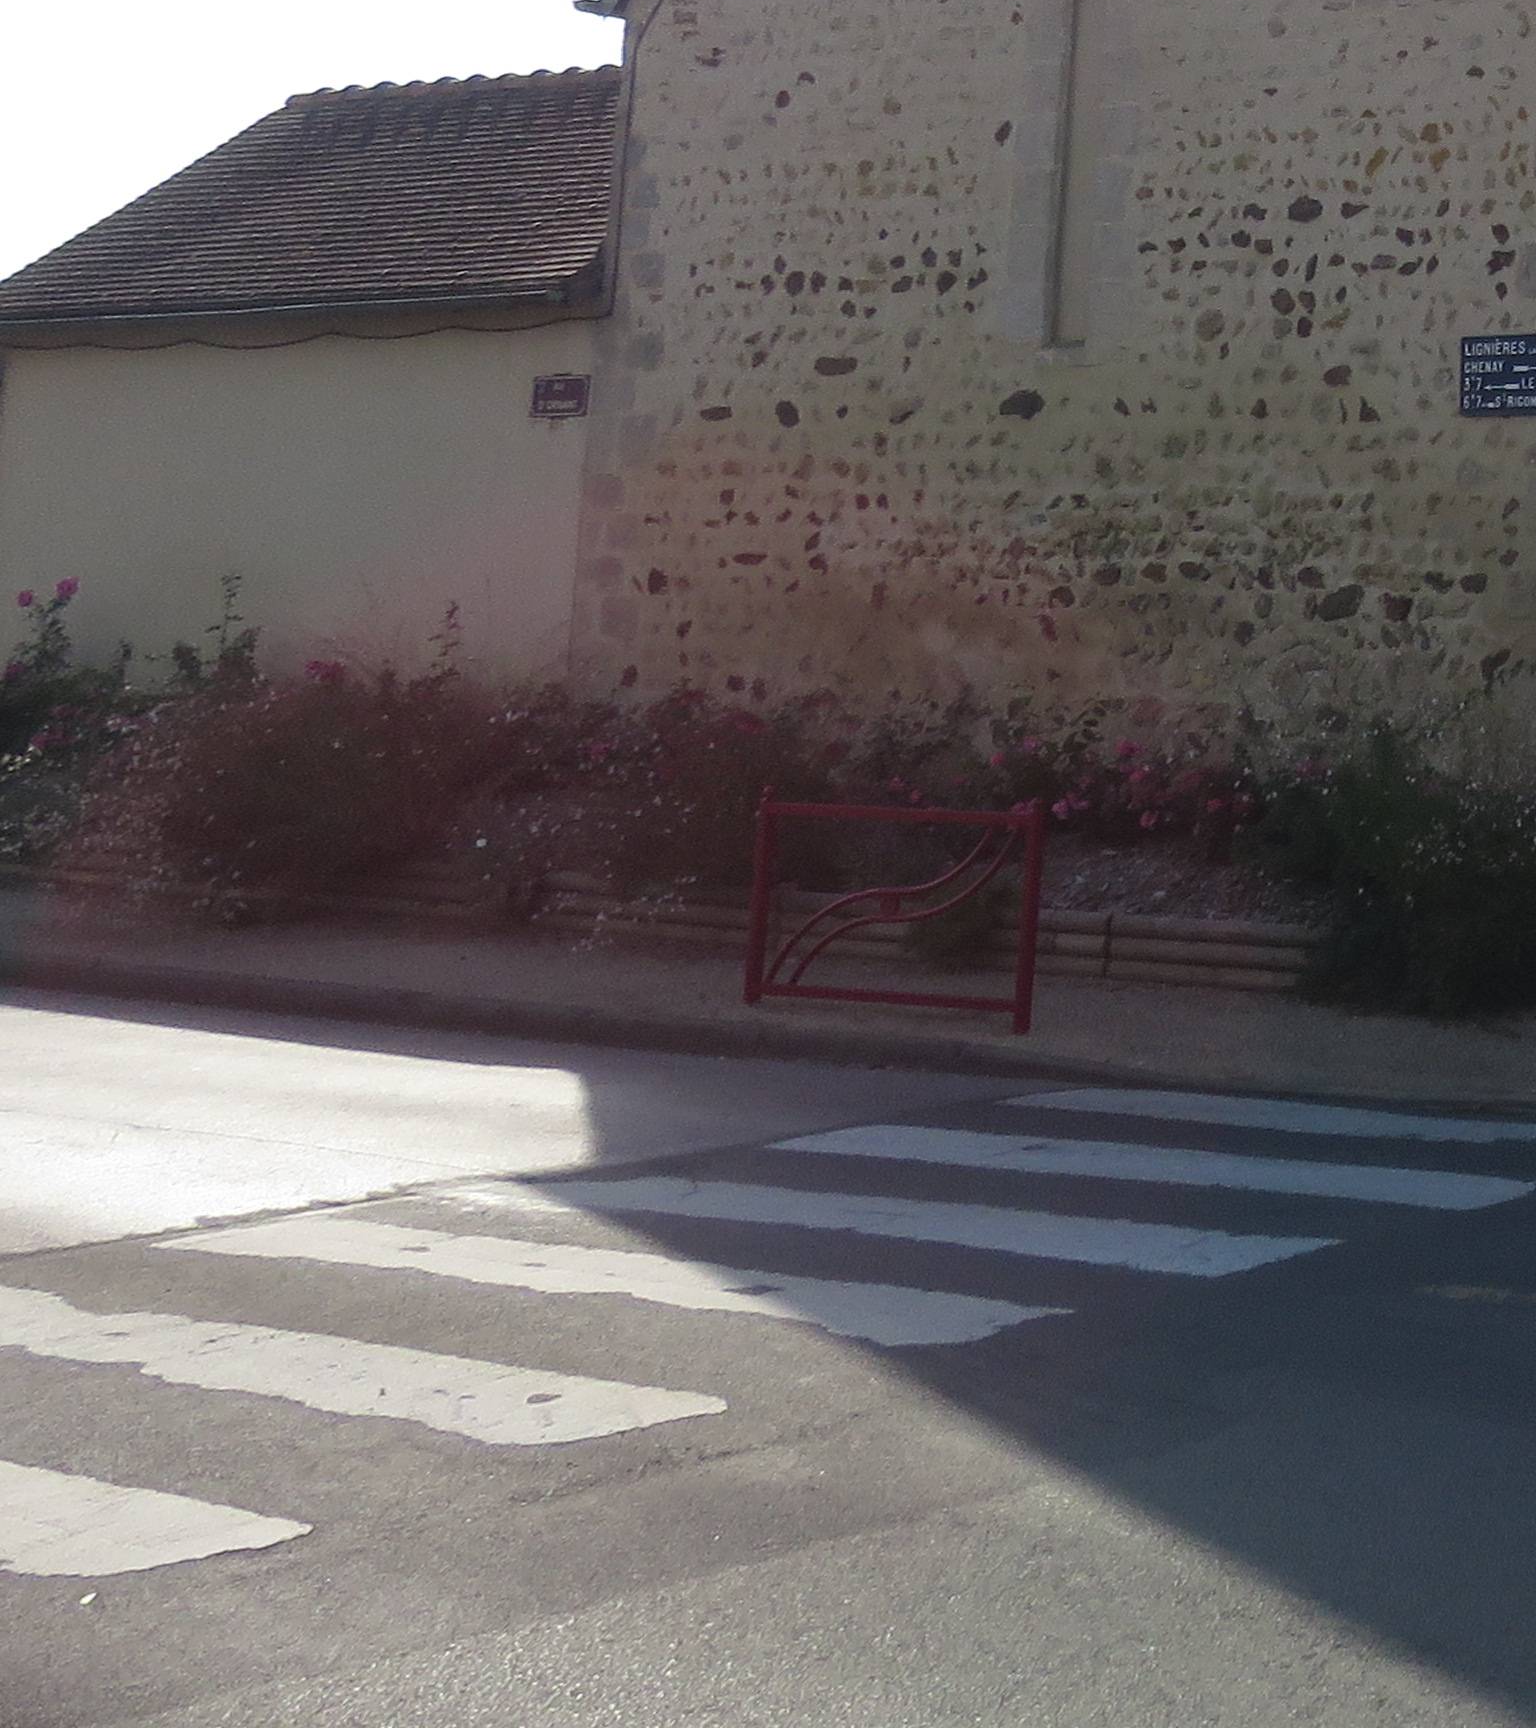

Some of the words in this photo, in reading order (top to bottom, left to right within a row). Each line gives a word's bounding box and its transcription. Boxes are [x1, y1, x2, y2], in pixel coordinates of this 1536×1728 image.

[1464, 339, 1526, 356] LIGNIÈRES
[1464, 360, 1505, 373] CHENAY
[1521, 377, 1535, 389] LE
